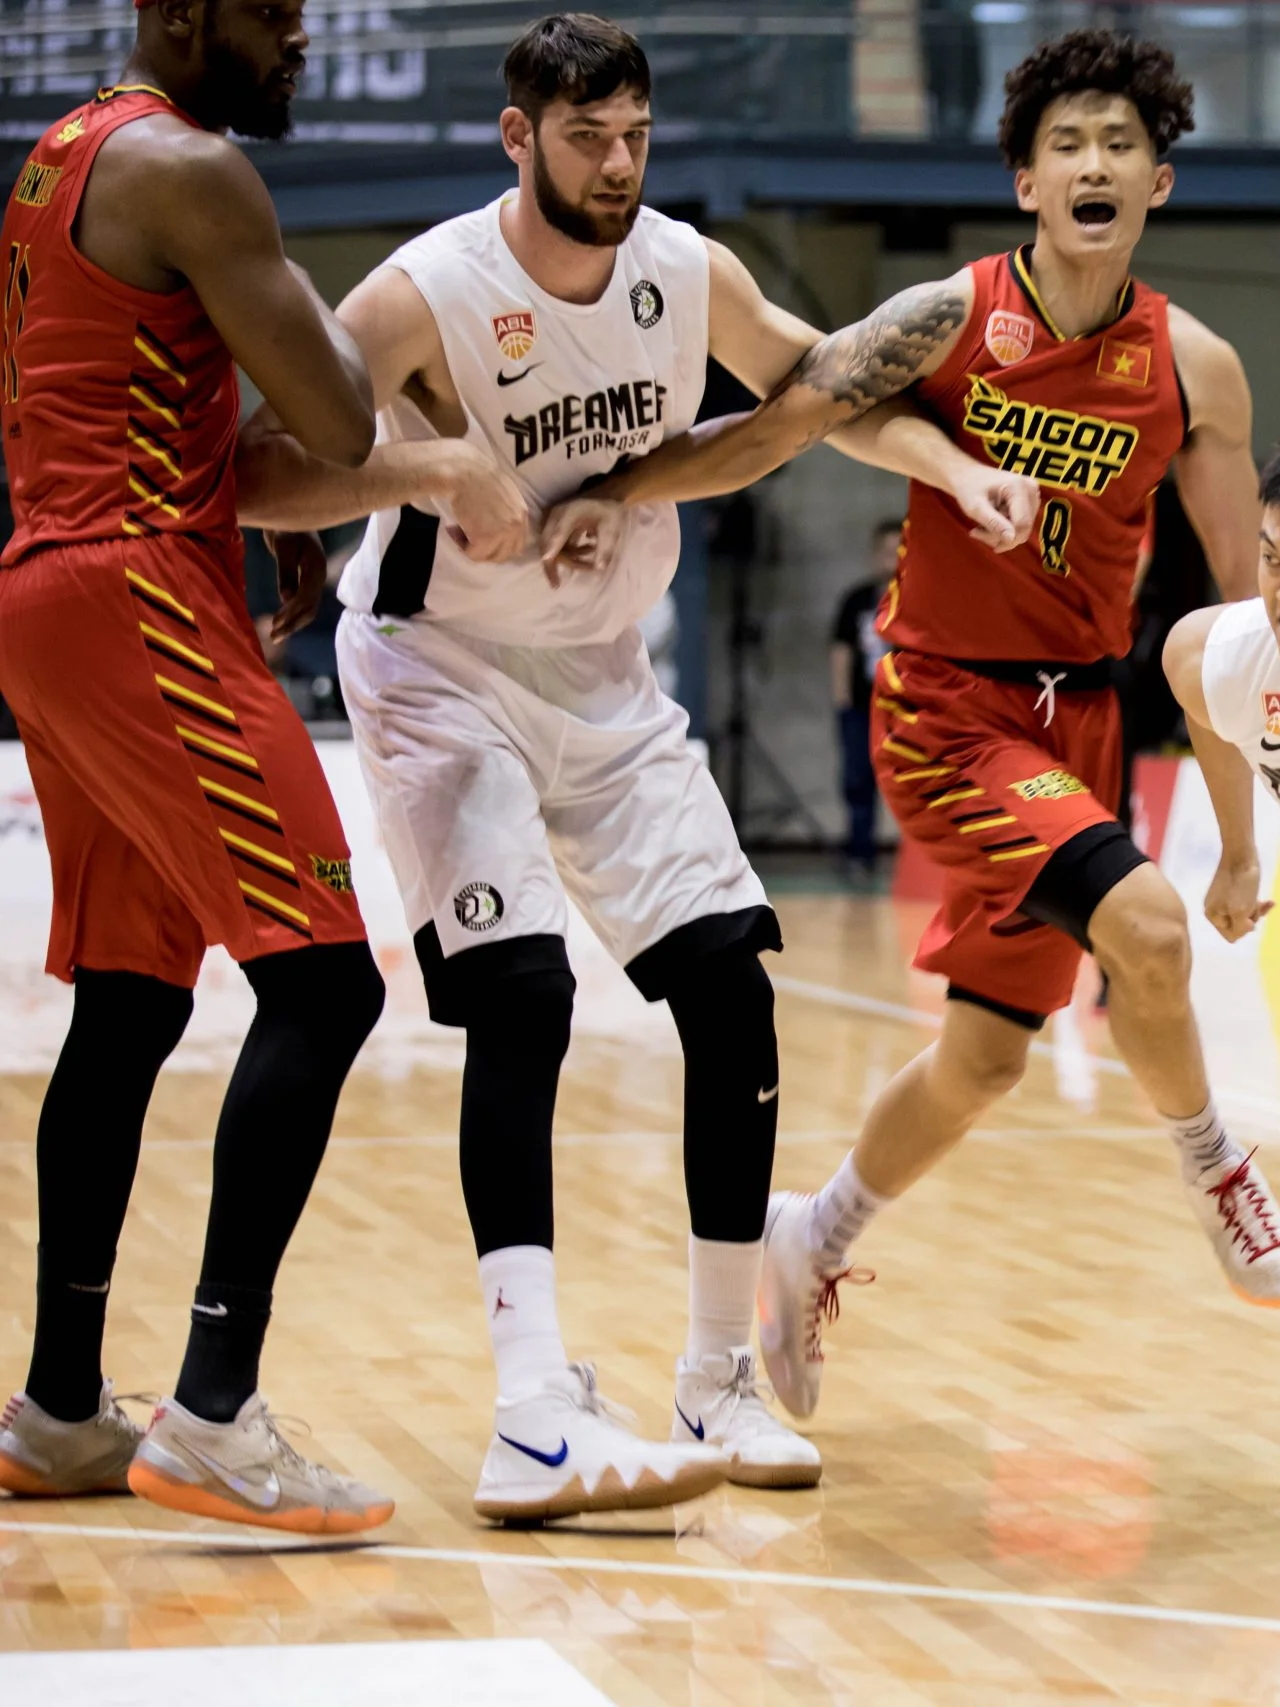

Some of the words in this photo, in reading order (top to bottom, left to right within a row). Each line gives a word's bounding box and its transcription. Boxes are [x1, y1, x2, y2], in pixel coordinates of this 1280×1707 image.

[497, 315, 533, 337] ABL
[993, 318, 1028, 342] ABL
[965, 399, 1137, 461] SAIGON
[986, 439, 1122, 495] HEAT
